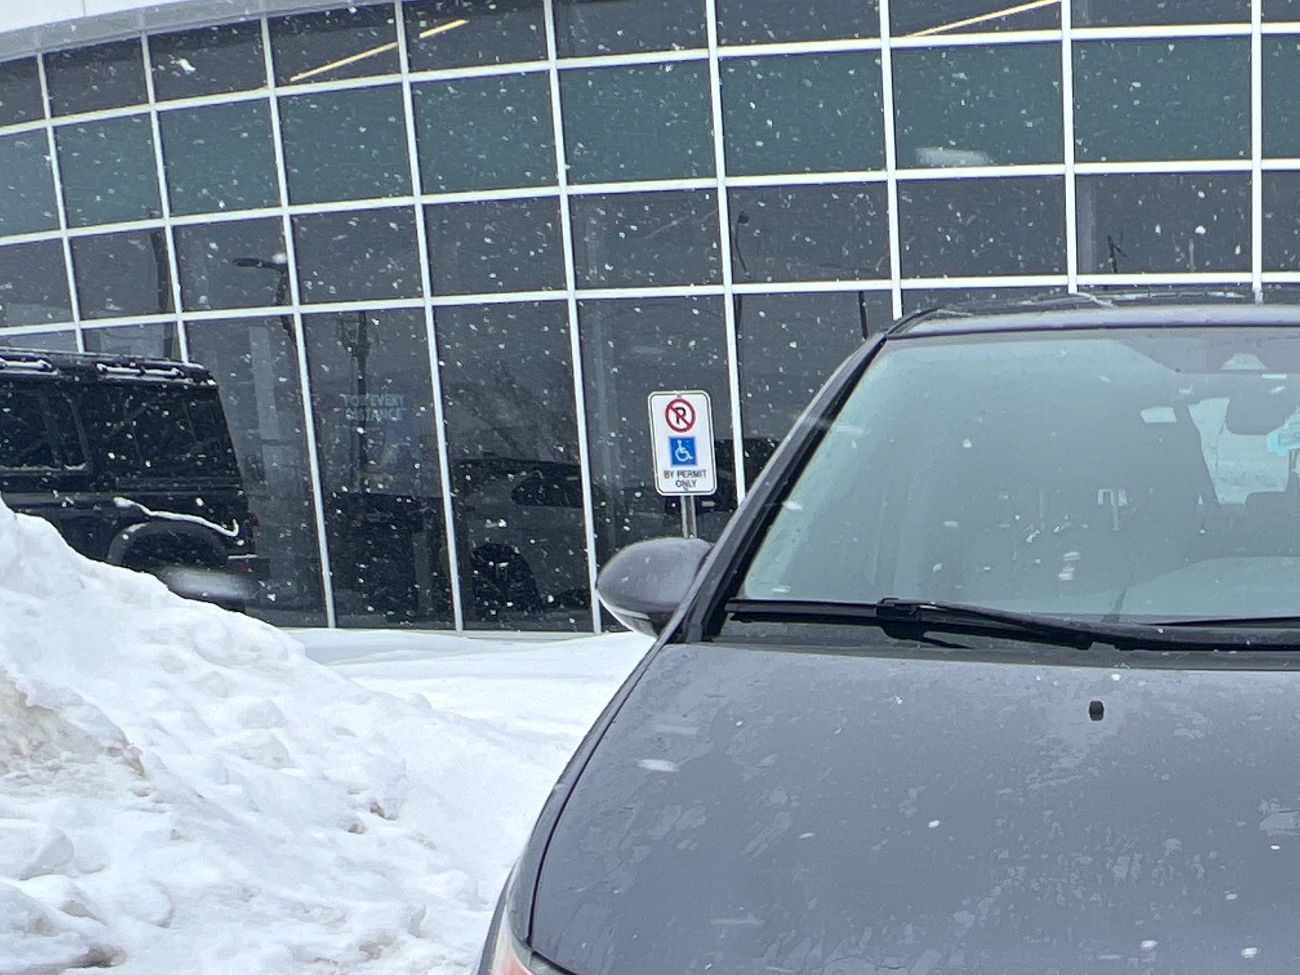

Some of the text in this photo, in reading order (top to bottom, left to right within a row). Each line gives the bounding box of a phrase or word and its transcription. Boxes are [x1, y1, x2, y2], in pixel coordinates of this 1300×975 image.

[663, 469, 707, 479] BY PERMIT
[675, 479, 697, 488] ONLY
